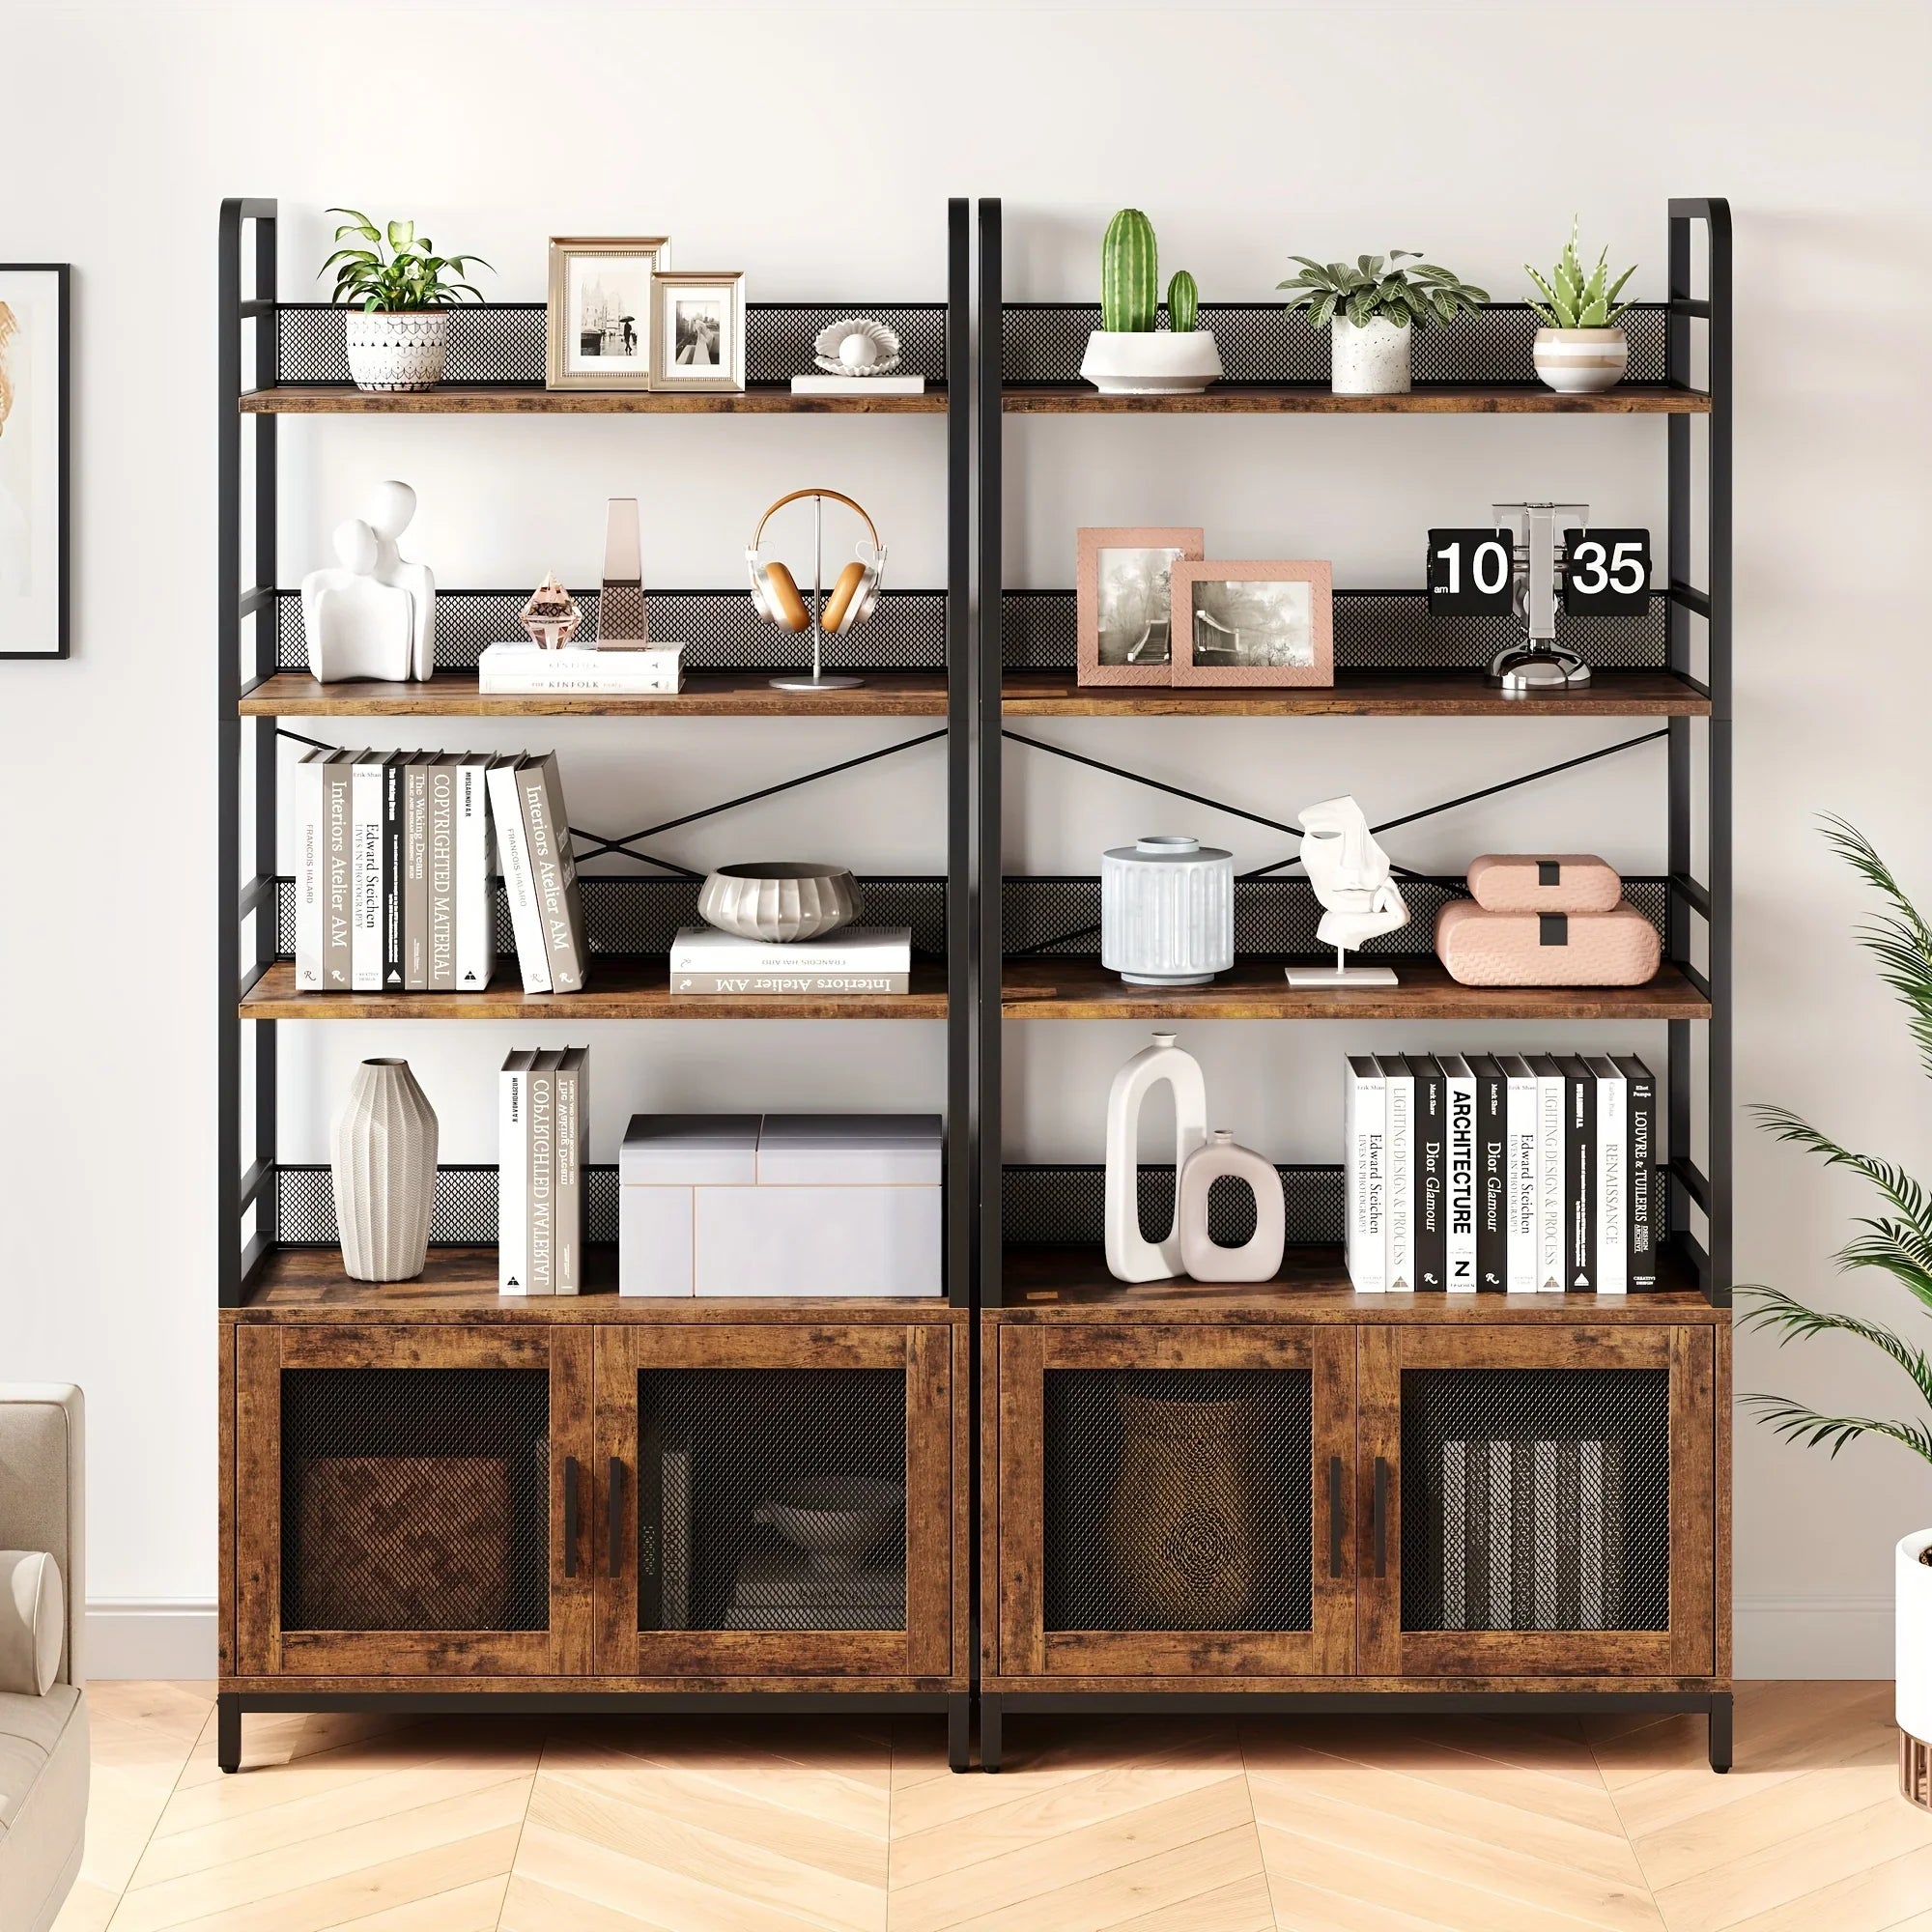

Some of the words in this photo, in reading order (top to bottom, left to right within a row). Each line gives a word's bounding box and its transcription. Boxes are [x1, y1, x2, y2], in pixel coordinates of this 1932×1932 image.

[1434, 585, 1448, 594] am
[1436, 541, 1509, 595] 10
[1572, 541, 1645, 595] 35
[415, 773, 425, 795] The
[331, 781, 348, 852] Interiors
[413, 798, 425, 839] Waking
[434, 774, 450, 893] COPYRIGHTED
[526, 784, 549, 857] Interiors
[366, 824, 380, 873] Edward
[415, 843, 425, 880] Dream
[507, 828, 522, 870] FRANCOIS
[331, 856, 349, 911] Atelier
[366, 875, 380, 928] Steichen
[539, 861, 560, 914] Atelier
[331, 915, 348, 948] AM
[434, 896, 450, 980] MATERIAL
[549, 919, 570, 952] AM
[715, 979, 750, 992] AM
[753, 979, 811, 992] Atelier
[817, 979, 892, 992] Interiors
[1393, 1088, 1406, 1147] LIGHTING
[1546, 1088, 1559, 1147] LIGHTING
[1634, 1111, 1648, 1158] LOUVRE
[1370, 1134, 1383, 1179] Edward
[1393, 1151, 1406, 1195] DESIGN
[1426, 1142, 1440, 1173] Dior
[1453, 1090, 1471, 1235] ARCHITECTURE
[1488, 1142, 1502, 1173] Dior
[1521, 1134, 1535, 1179] Edward
[1546, 1151, 1559, 1195] DESIGN
[1634, 1160, 1644, 1169] &
[1370, 1183, 1382, 1235] Steichen
[1393, 1198, 1406, 1208] &
[1426, 1177, 1440, 1232] Glamour
[1488, 1177, 1502, 1232] Glamour
[1521, 1183, 1534, 1235] Steichen
[1546, 1198, 1559, 1208] &
[1605, 1144, 1619, 1245] RENAISSANCE
[1634, 1170, 1648, 1222] TUILERIS
[1393, 1211, 1406, 1265] PROCESS
[1546, 1211, 1559, 1265] PROCESS
[1454, 1261, 1470, 1277] N
